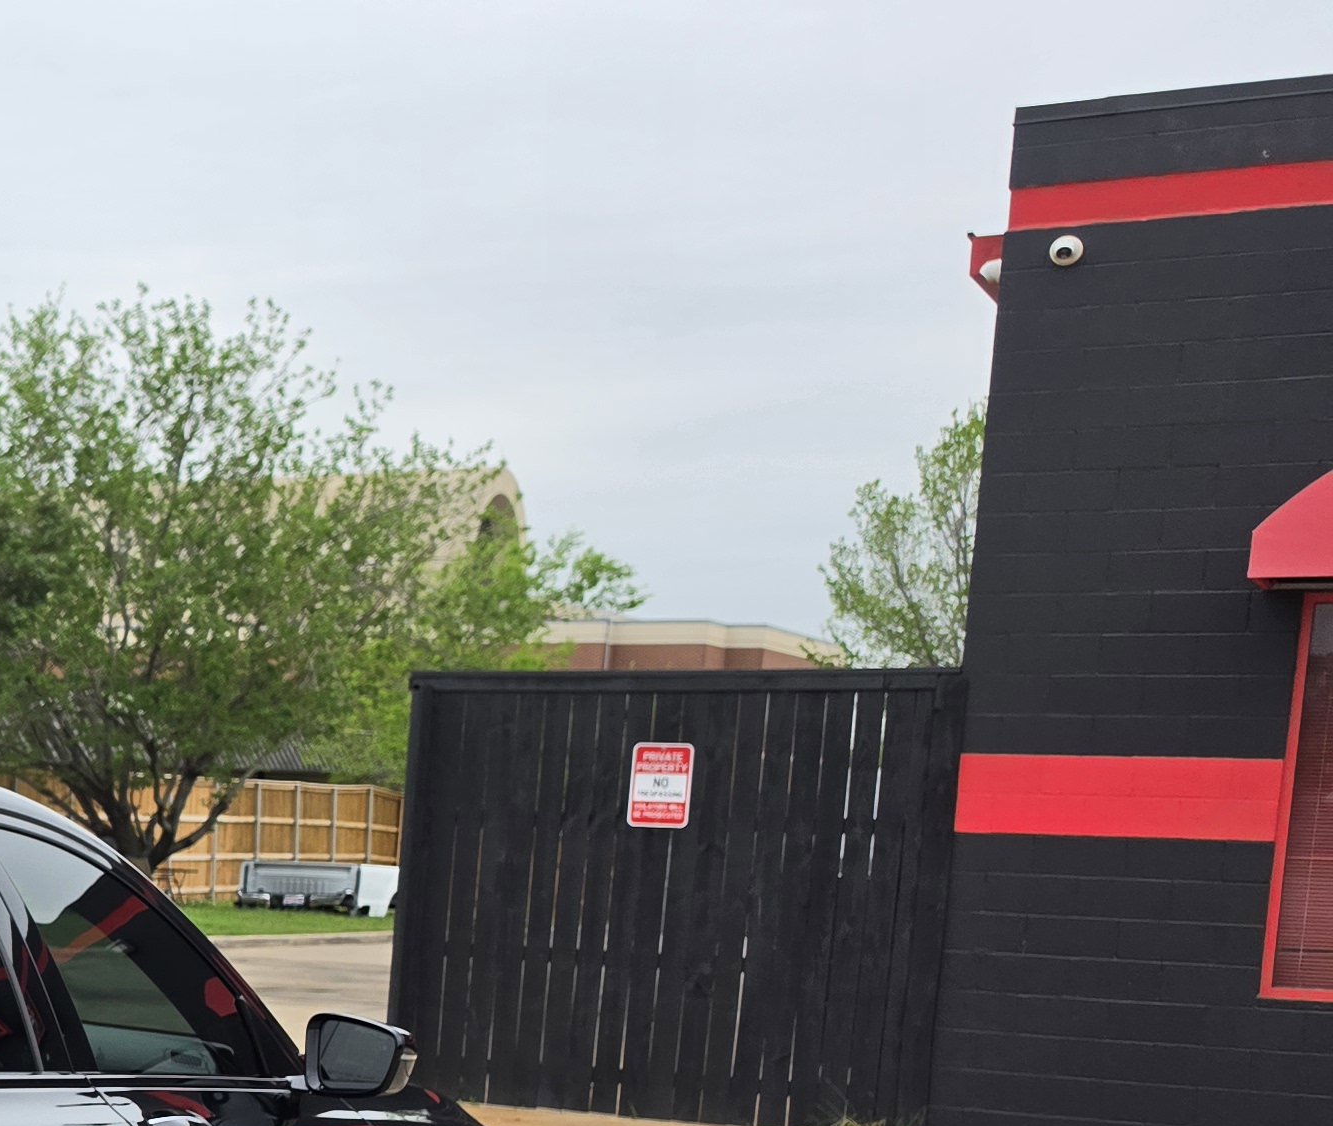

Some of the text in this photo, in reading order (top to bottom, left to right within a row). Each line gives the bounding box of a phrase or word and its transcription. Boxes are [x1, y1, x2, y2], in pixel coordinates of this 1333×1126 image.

[643, 751, 684, 762] PRIVATE
[636, 761, 688, 772] PROPERTY
[652, 777, 669, 788] NO
